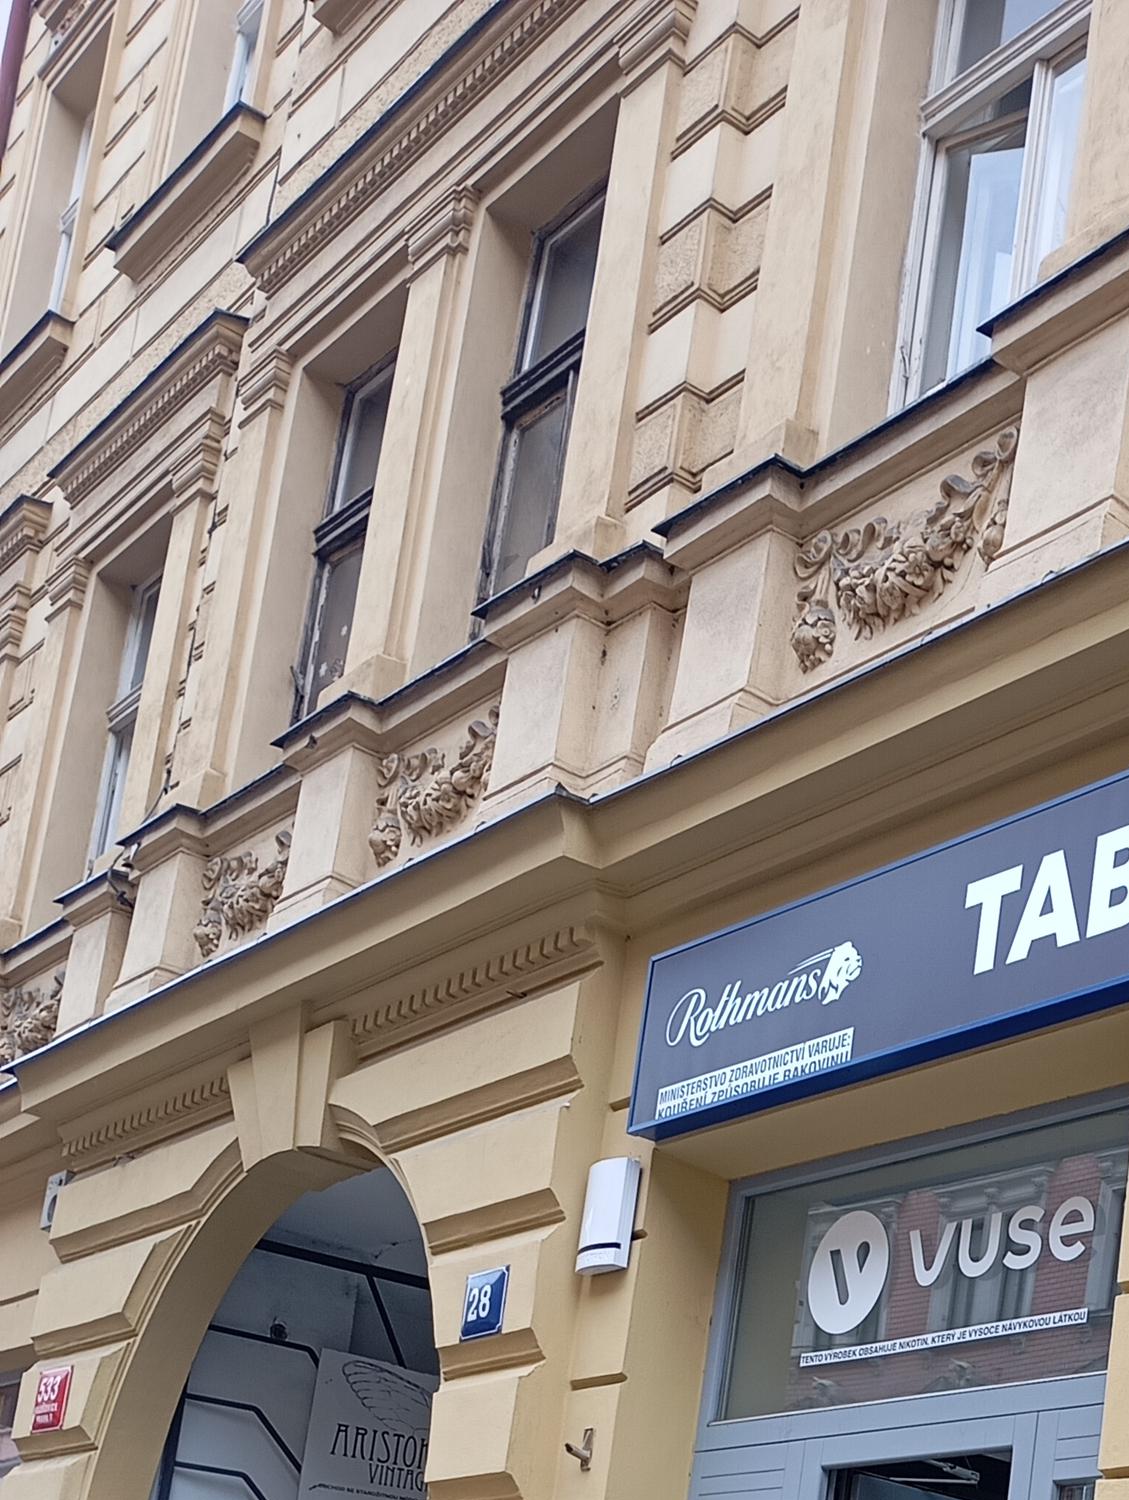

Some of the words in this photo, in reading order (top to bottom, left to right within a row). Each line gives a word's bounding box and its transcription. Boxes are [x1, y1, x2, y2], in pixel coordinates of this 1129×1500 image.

[665, 965, 824, 1048] Rothmans
[659, 1073, 727, 1105] MINISTERSTVO
[728, 1042, 807, 1083] ZDRAVOTNICTVÍ
[807, 1032, 851, 1059] VARUJE:
[466, 1283, 492, 1322] 28
[801, 1353, 823, 1366] TENTO
[823, 1348, 858, 1363] VÝROBEK
[858, 1341, 898, 1358] OBSAHUJE
[956, 1329, 968, 1341] JE
[968, 1323, 1000, 1339] VYSOCE
[1001, 1314, 1052, 1334] NÁVYKOVOU
[1052, 1310, 1087, 1326] LÁTKOU
[369, 1462, 428, 1493] VINTAG
